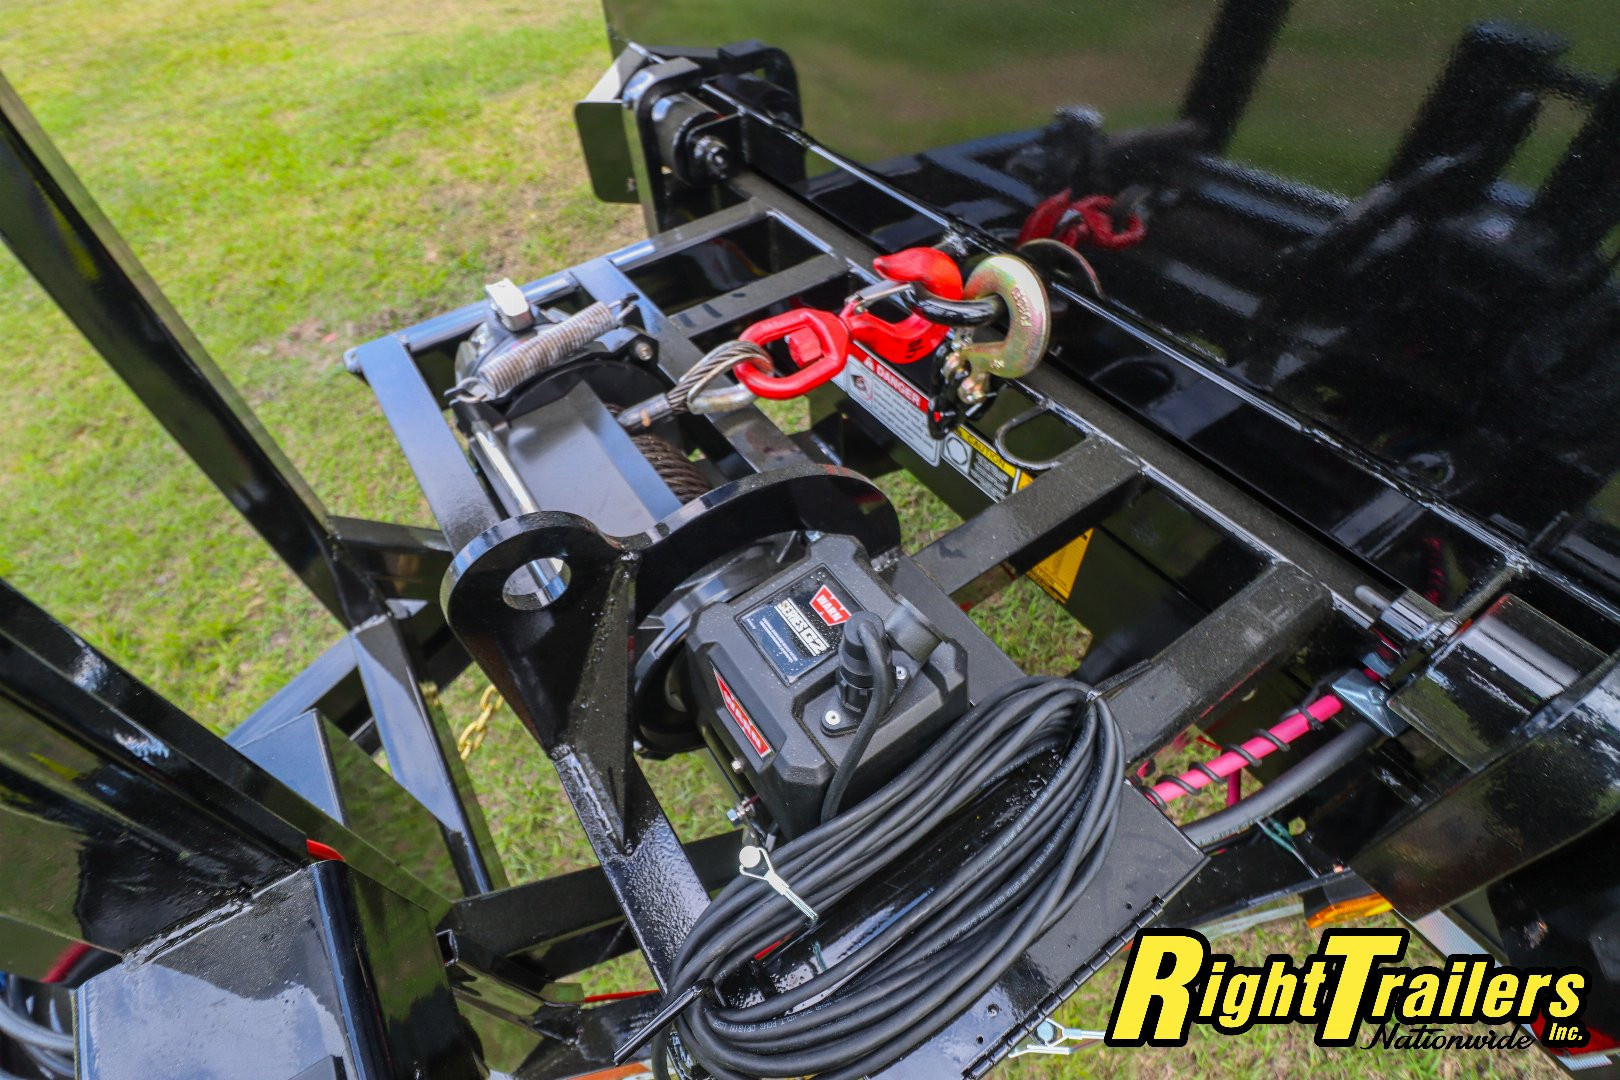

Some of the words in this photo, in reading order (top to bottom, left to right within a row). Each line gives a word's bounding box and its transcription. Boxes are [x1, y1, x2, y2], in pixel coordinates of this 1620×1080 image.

[874, 364, 921, 406] DANGER
[776, 598, 808, 633] SERIES
[799, 626, 827, 655] G2
[816, 594, 842, 621] WARN
